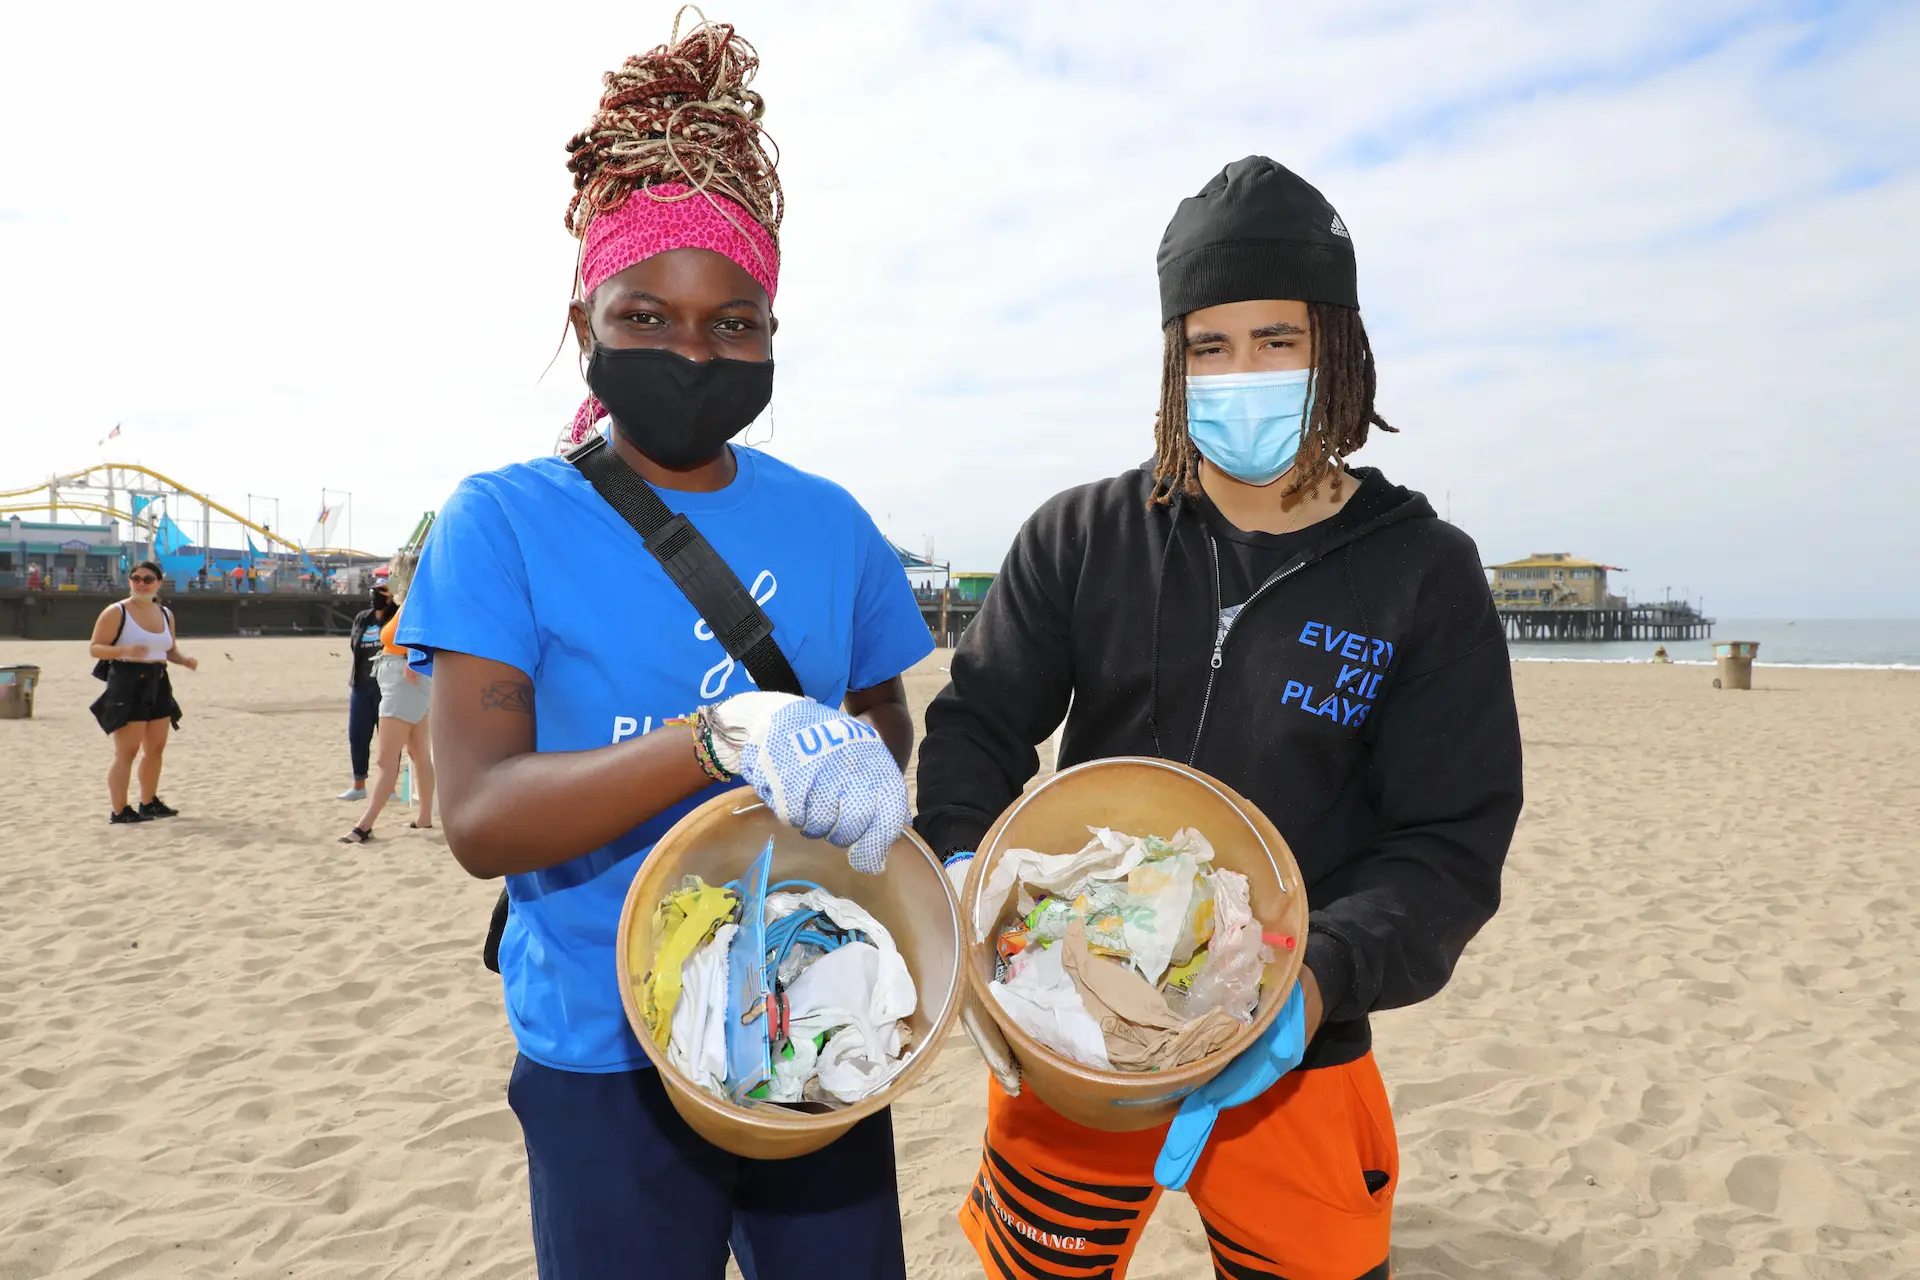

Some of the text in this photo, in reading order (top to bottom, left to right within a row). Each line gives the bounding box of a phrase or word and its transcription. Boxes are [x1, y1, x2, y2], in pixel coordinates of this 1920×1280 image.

[1281, 680, 1371, 727] PLAYS
[1000, 1207, 1086, 1250] OF ORANGE
